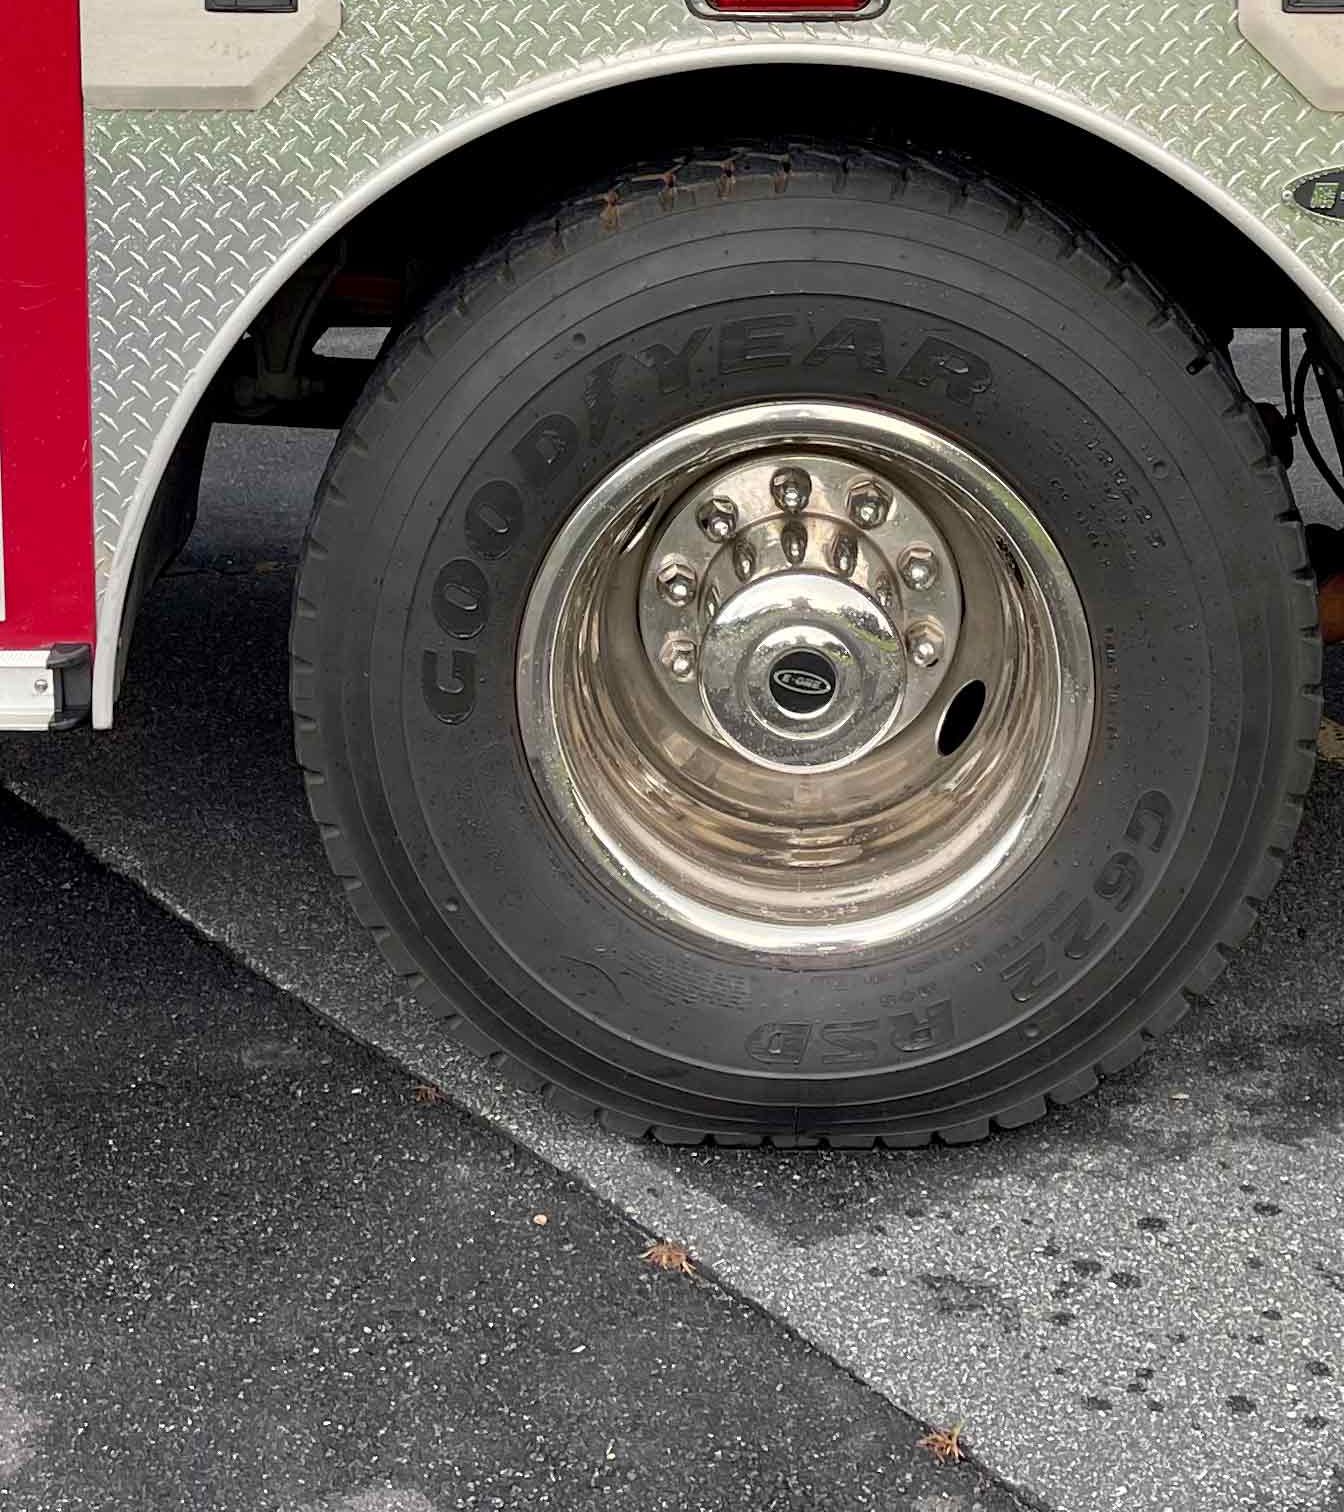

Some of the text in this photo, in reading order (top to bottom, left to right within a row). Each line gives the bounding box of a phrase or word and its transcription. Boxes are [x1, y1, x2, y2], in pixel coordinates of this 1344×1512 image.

[421, 312, 993, 726] GOODYEAR
[782, 673, 823, 690] E-ONE
[999, 790, 1175, 1003] G622
[746, 997, 954, 1065] RSD
